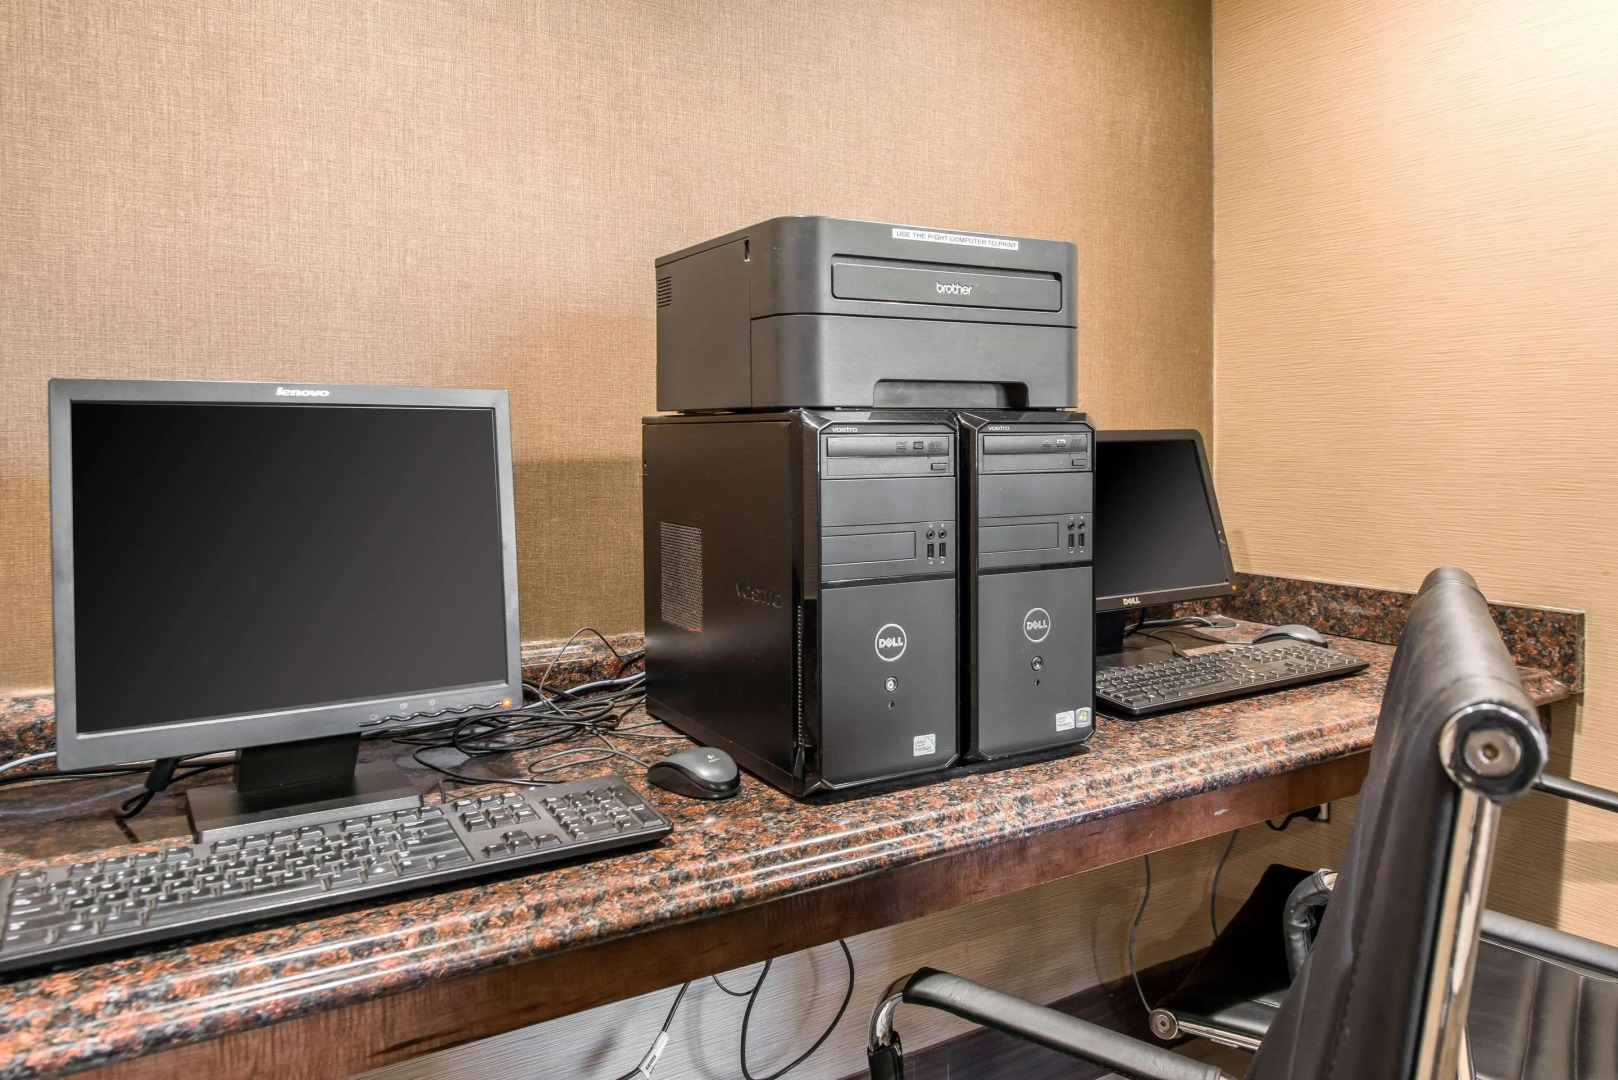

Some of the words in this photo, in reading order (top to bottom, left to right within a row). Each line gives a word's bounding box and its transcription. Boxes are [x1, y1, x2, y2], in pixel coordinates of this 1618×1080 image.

[896, 230, 911, 238] USE
[913, 231, 926, 239] THE
[927, 233, 948, 242] RIGHT
[949, 235, 987, 246] COMPUTER
[988, 239, 997, 247] TO
[998, 240, 1017, 249] PRINT
[936, 281, 973, 296] brother
[276, 386, 330, 397] lenovo
[1122, 596, 1141, 606] DELL
[1026, 619, 1047, 630] DELL
[878, 636, 903, 648] DELL
